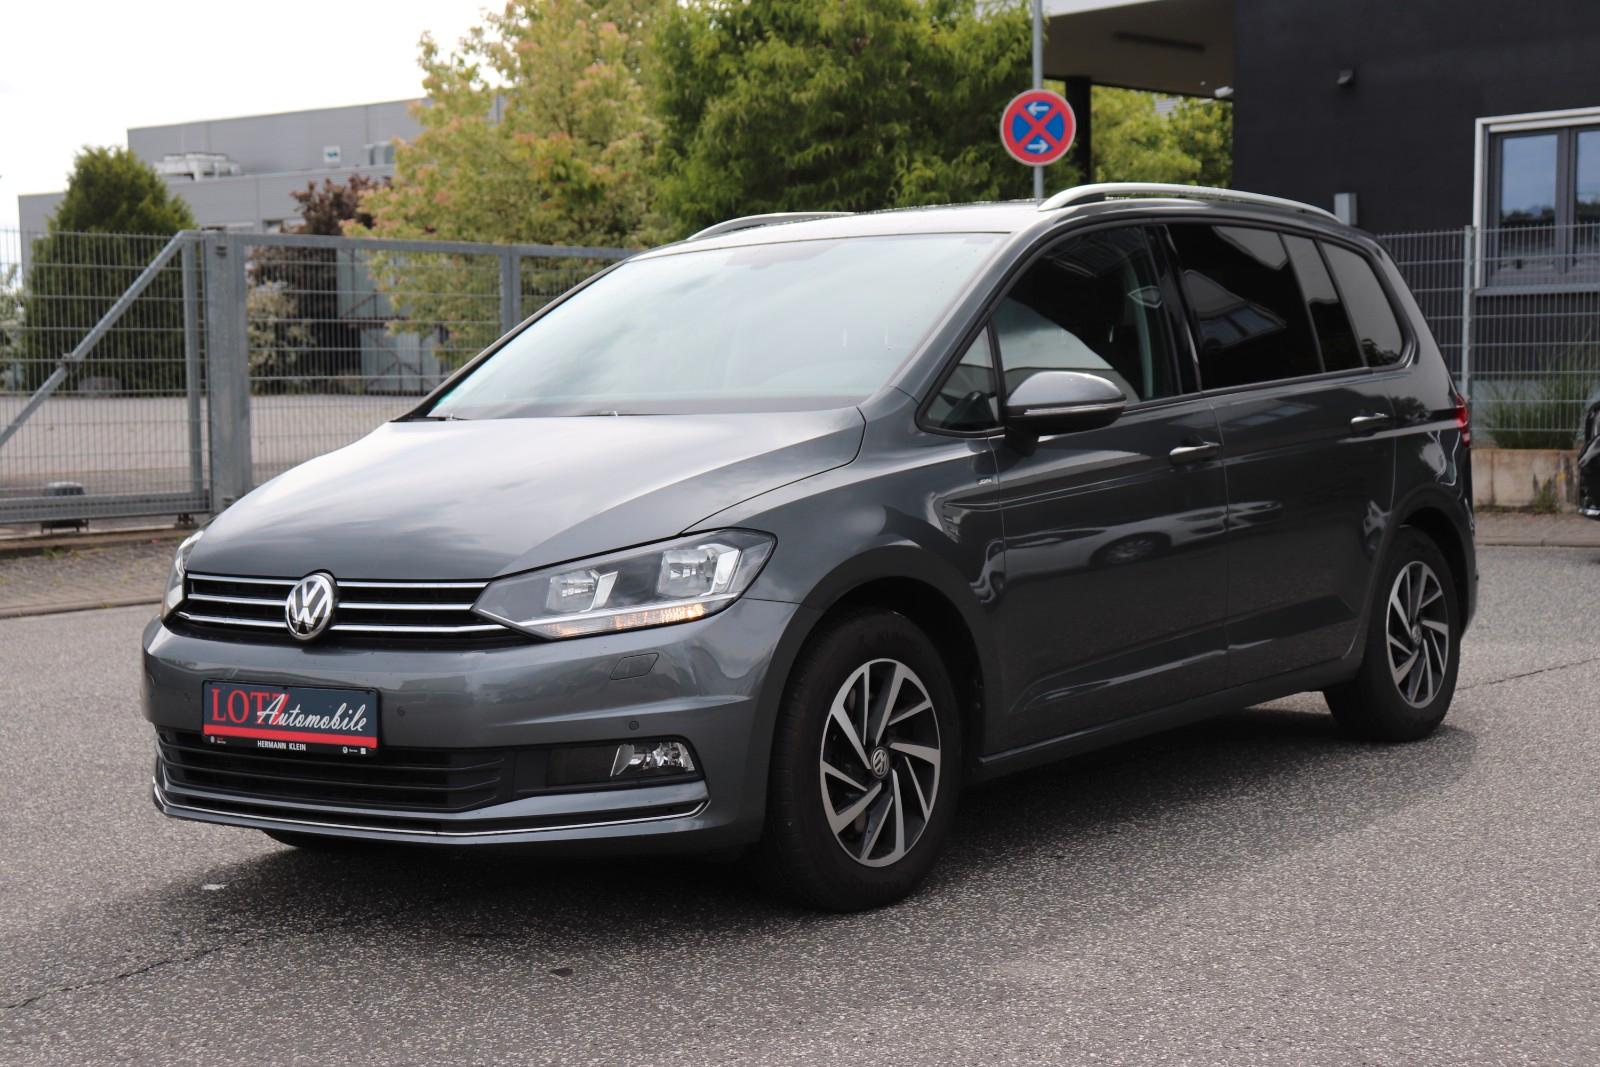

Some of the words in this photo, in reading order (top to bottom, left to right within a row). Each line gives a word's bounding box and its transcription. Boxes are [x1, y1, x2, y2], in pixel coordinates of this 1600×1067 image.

[286, 574, 332, 638] VW
[211, 688, 289, 725] LOTZ
[257, 694, 367, 731] Automobile
[257, 740, 287, 751] HERMANN
[289, 743, 307, 752] KLEIN
